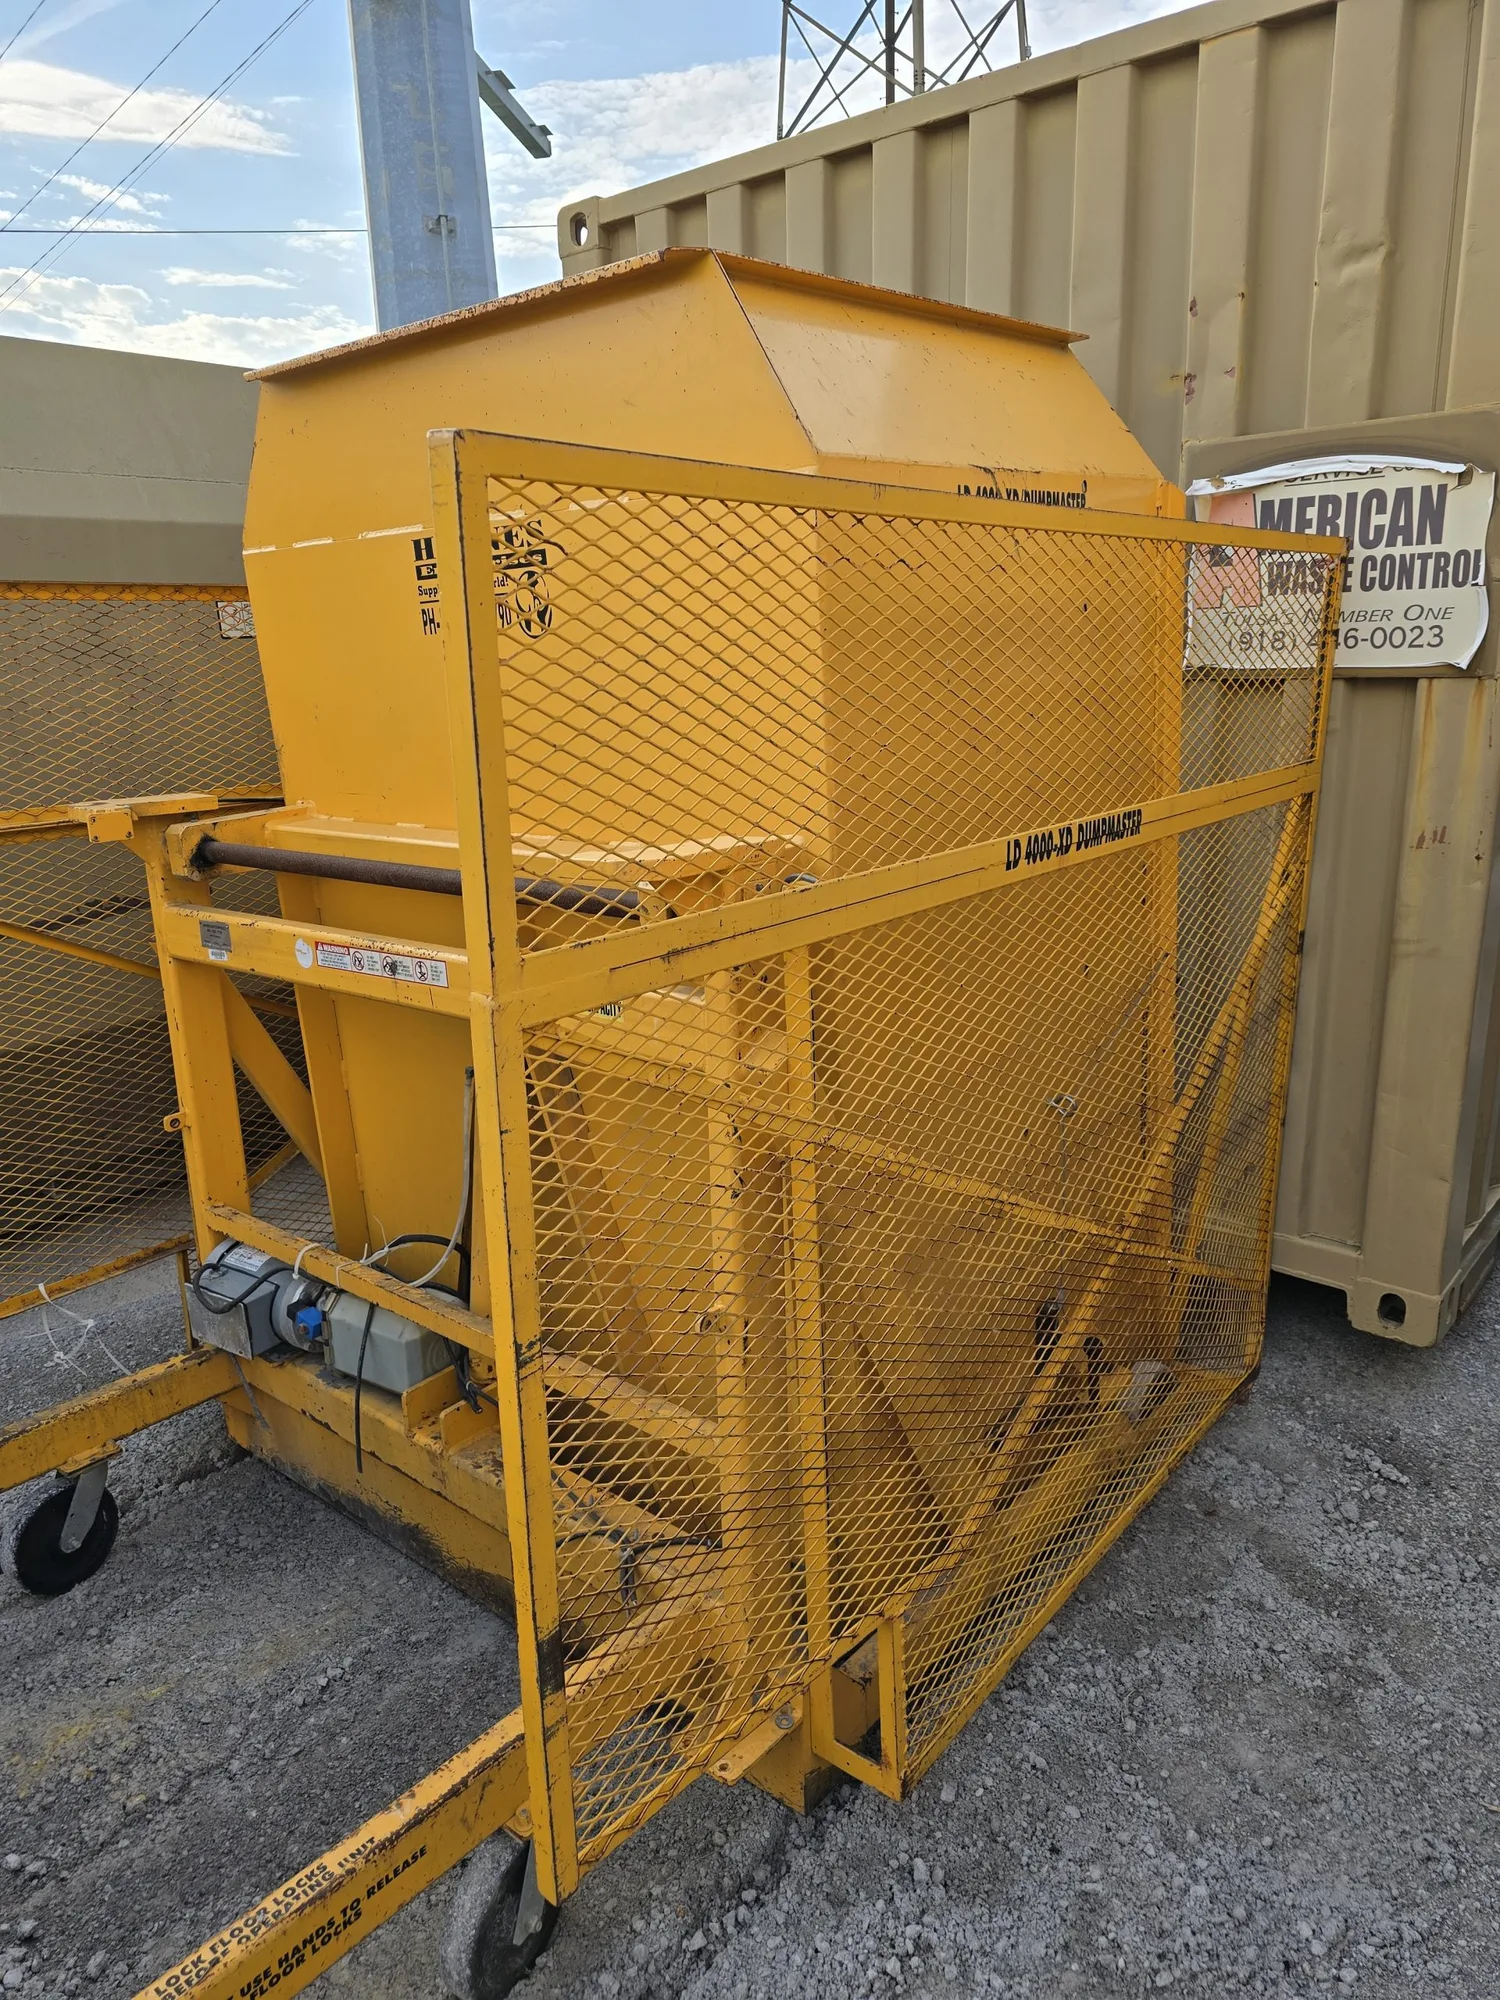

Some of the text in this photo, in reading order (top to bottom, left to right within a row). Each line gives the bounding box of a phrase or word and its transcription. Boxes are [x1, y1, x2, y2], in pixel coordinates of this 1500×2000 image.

[976, 485, 1019, 502] 4000XD
[1267, 556, 1355, 596] WASE
[421, 608, 440, 635] PH.
[1303, 607, 1394, 625] NMBER
[1403, 604, 1455, 621] ONE
[1005, 808, 1143, 871] LD 4000-XD DUMPMASTER
[322, 943, 349, 955] WARNING
[154, 1862, 328, 1998] LOCK FLOOR LOCKS
[161, 1947, 231, 2000] BEFORE
[237, 1870, 335, 1946] OPERATING
[240, 1844, 427, 1998] USE HANDS TO RELEASE
[249, 1908, 362, 2000] FLOOR LOCKS
